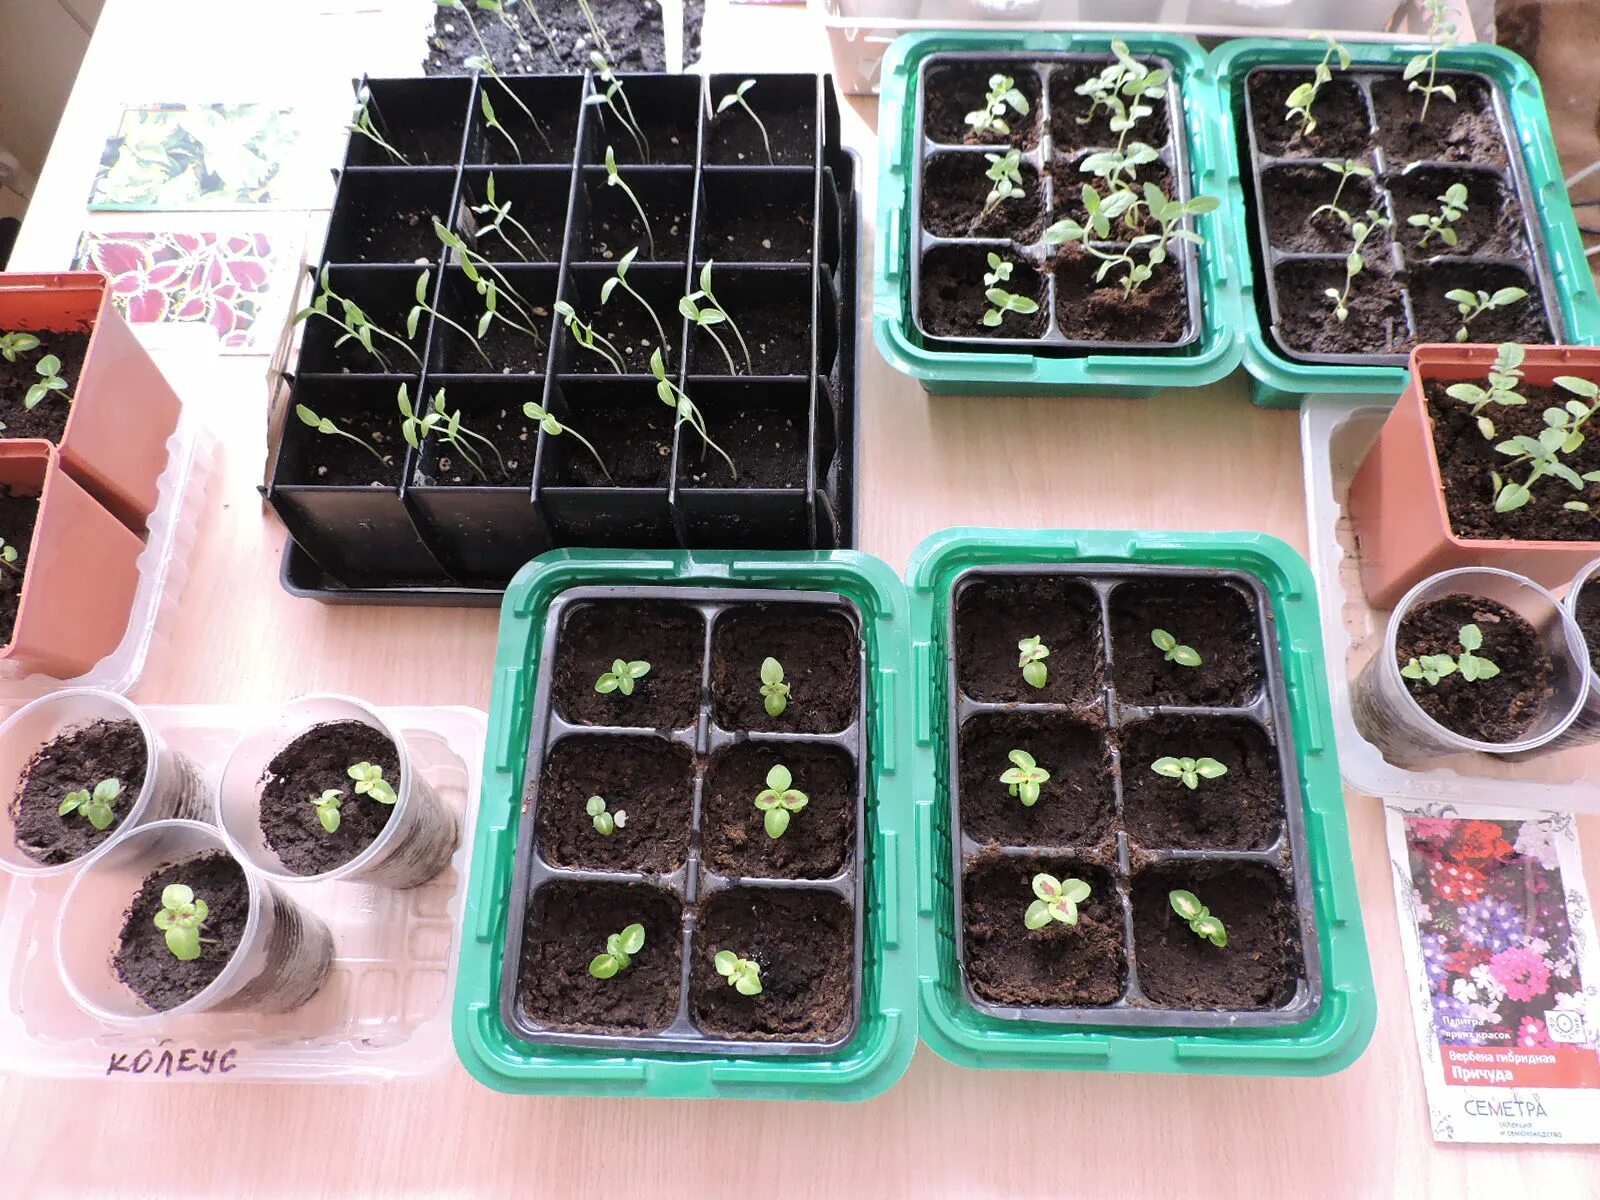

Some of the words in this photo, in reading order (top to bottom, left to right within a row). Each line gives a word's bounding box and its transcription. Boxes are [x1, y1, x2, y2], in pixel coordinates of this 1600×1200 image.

[1476, 1031, 1511, 1040] красок
[106, 1049, 238, 1077] КОЛЕУС
[1449, 1051, 1494, 1064] Вербена
[1496, 1050, 1556, 1065] гибридная
[1451, 1066, 1514, 1083] Причуда
[1464, 1100, 1548, 1117] СЕМЕТРА
